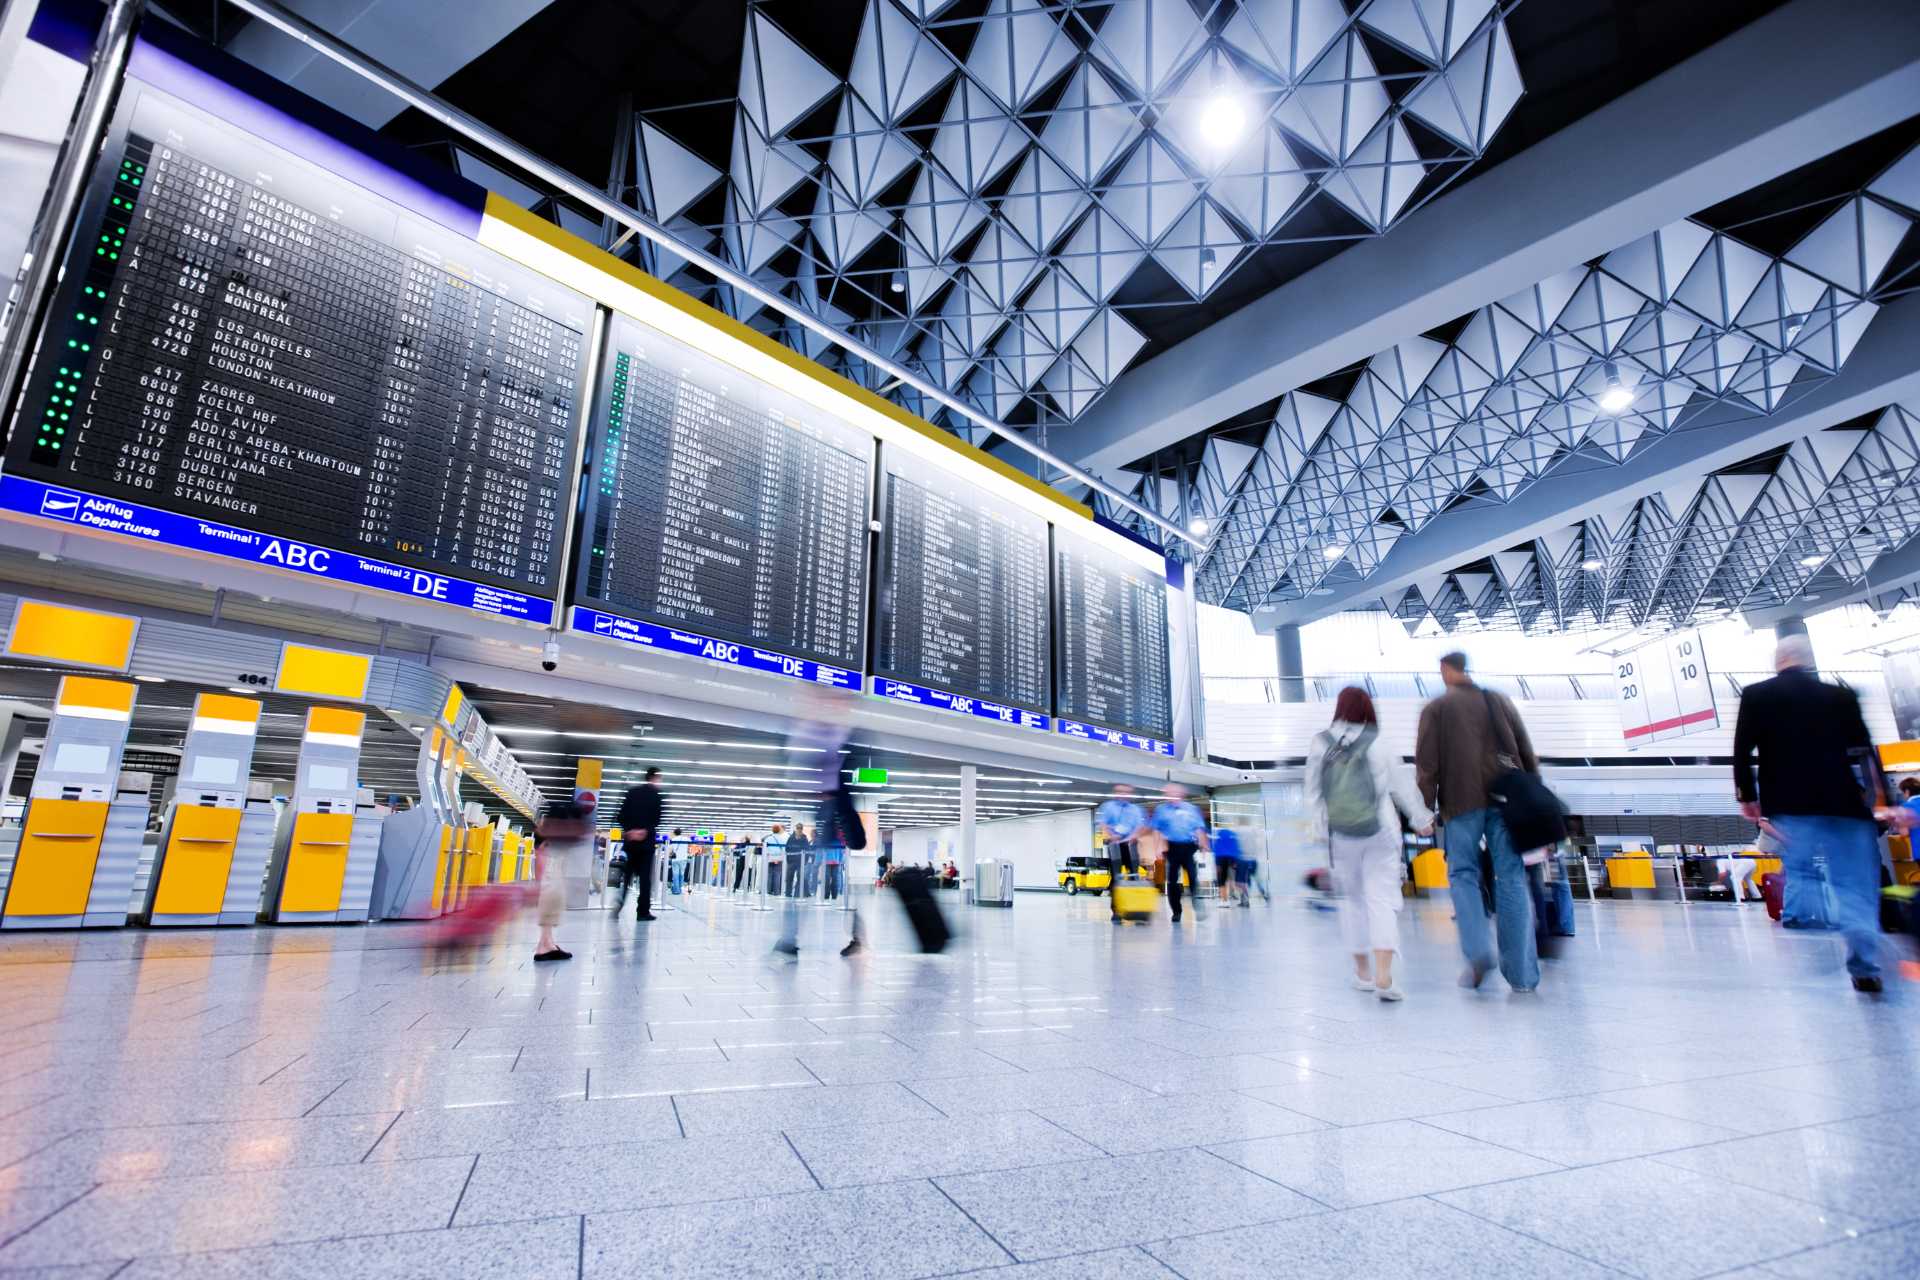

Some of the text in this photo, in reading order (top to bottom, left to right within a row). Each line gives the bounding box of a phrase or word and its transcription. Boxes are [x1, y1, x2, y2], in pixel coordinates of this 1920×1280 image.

[143, 208, 153, 220] L
[151, 184, 160, 196] L
[242, 223, 284, 246] MIAMI
[154, 172, 164, 184] L
[245, 212, 311, 245] PORTLAND
[158, 160, 167, 172] L
[248, 200, 314, 234] HELSINKI
[129, 258, 139, 269] A
[179, 277, 206, 293] 875
[224, 294, 292, 325] MONTREAL
[133, 245, 142, 257] L
[182, 265, 209, 281] 494
[227, 282, 287, 310] CALGARY
[114, 309, 124, 321] L
[165, 327, 193, 343] 440
[211, 343, 273, 369] HOUSTON
[118, 296, 128, 308] L
[168, 314, 196, 330] 442
[214, 330, 276, 357] DETROIT
[121, 283, 132, 295] L
[172, 302, 200, 318] 456
[218, 318, 244, 333] LOS
[253, 331, 311, 357] ANGELES
[102, 348, 113, 360] O
[154, 365, 183, 381] 417
[201, 380, 255, 404] ZAGREB
[110, 322, 120, 334] L
[152, 336, 190, 355] 4726
[208, 355, 335, 403] LONDON-HEATHROW
[94, 375, 105, 387] L
[147, 392, 176, 407] 686
[195, 406, 222, 421] TEL
[232, 417, 267, 434] AVIV
[98, 362, 109, 374] L
[141, 376, 180, 394] 6808
[198, 393, 244, 413] KOELN
[252, 410, 278, 424] HBF
[78, 430, 89, 443] L
[122, 443, 162, 461] 4980
[181, 459, 237, 480] DUBLIN
[82, 416, 93, 428] J
[136, 432, 166, 447] 117
[184, 446, 267, 475] LJUBLJANA
[86, 403, 97, 415] L
[140, 419, 169, 434] 176
[188, 432, 295, 469] BERLIN-TEGEL
[90, 389, 101, 401] L
[143, 405, 173, 420] 590
[191, 419, 237, 439] ADDIS
[246, 435, 362, 475] ABEBA-KHARTOUM
[70, 459, 81, 471] L
[114, 471, 155, 488] 3160
[174, 486, 258, 514] STAVANGER
[74, 445, 85, 457] L
[118, 457, 158, 474] 3126
[178, 472, 234, 494] BERGEN
[80, 511, 160, 537] Departures
[83, 498, 134, 519] Abflug
[199, 524, 449, 599] Terminal 1 ABC Terminal 2 DE
[658, 575, 696, 592] HELSINKI
[659, 565, 692, 581] TORONTO
[660, 555, 693, 572] VILNIUS
[655, 605, 684, 619] DUBLIN
[657, 585, 700, 603] AMSTERDAM
[613, 628, 653, 644] Departures
[614, 619, 639, 633] Abflug
[1676, 641, 1692, 658] 10
[670, 631, 697, 644] Terminal
[702, 641, 739, 663] ABC
[783, 658, 804, 676] DE
[1618, 662, 1634, 678] 20
[1680, 664, 1697, 680] 10
[238, 673, 267, 685] 464
[1622, 684, 1638, 700] 20
[950, 696, 973, 713] ABC
[999, 706, 1014, 722] DE
